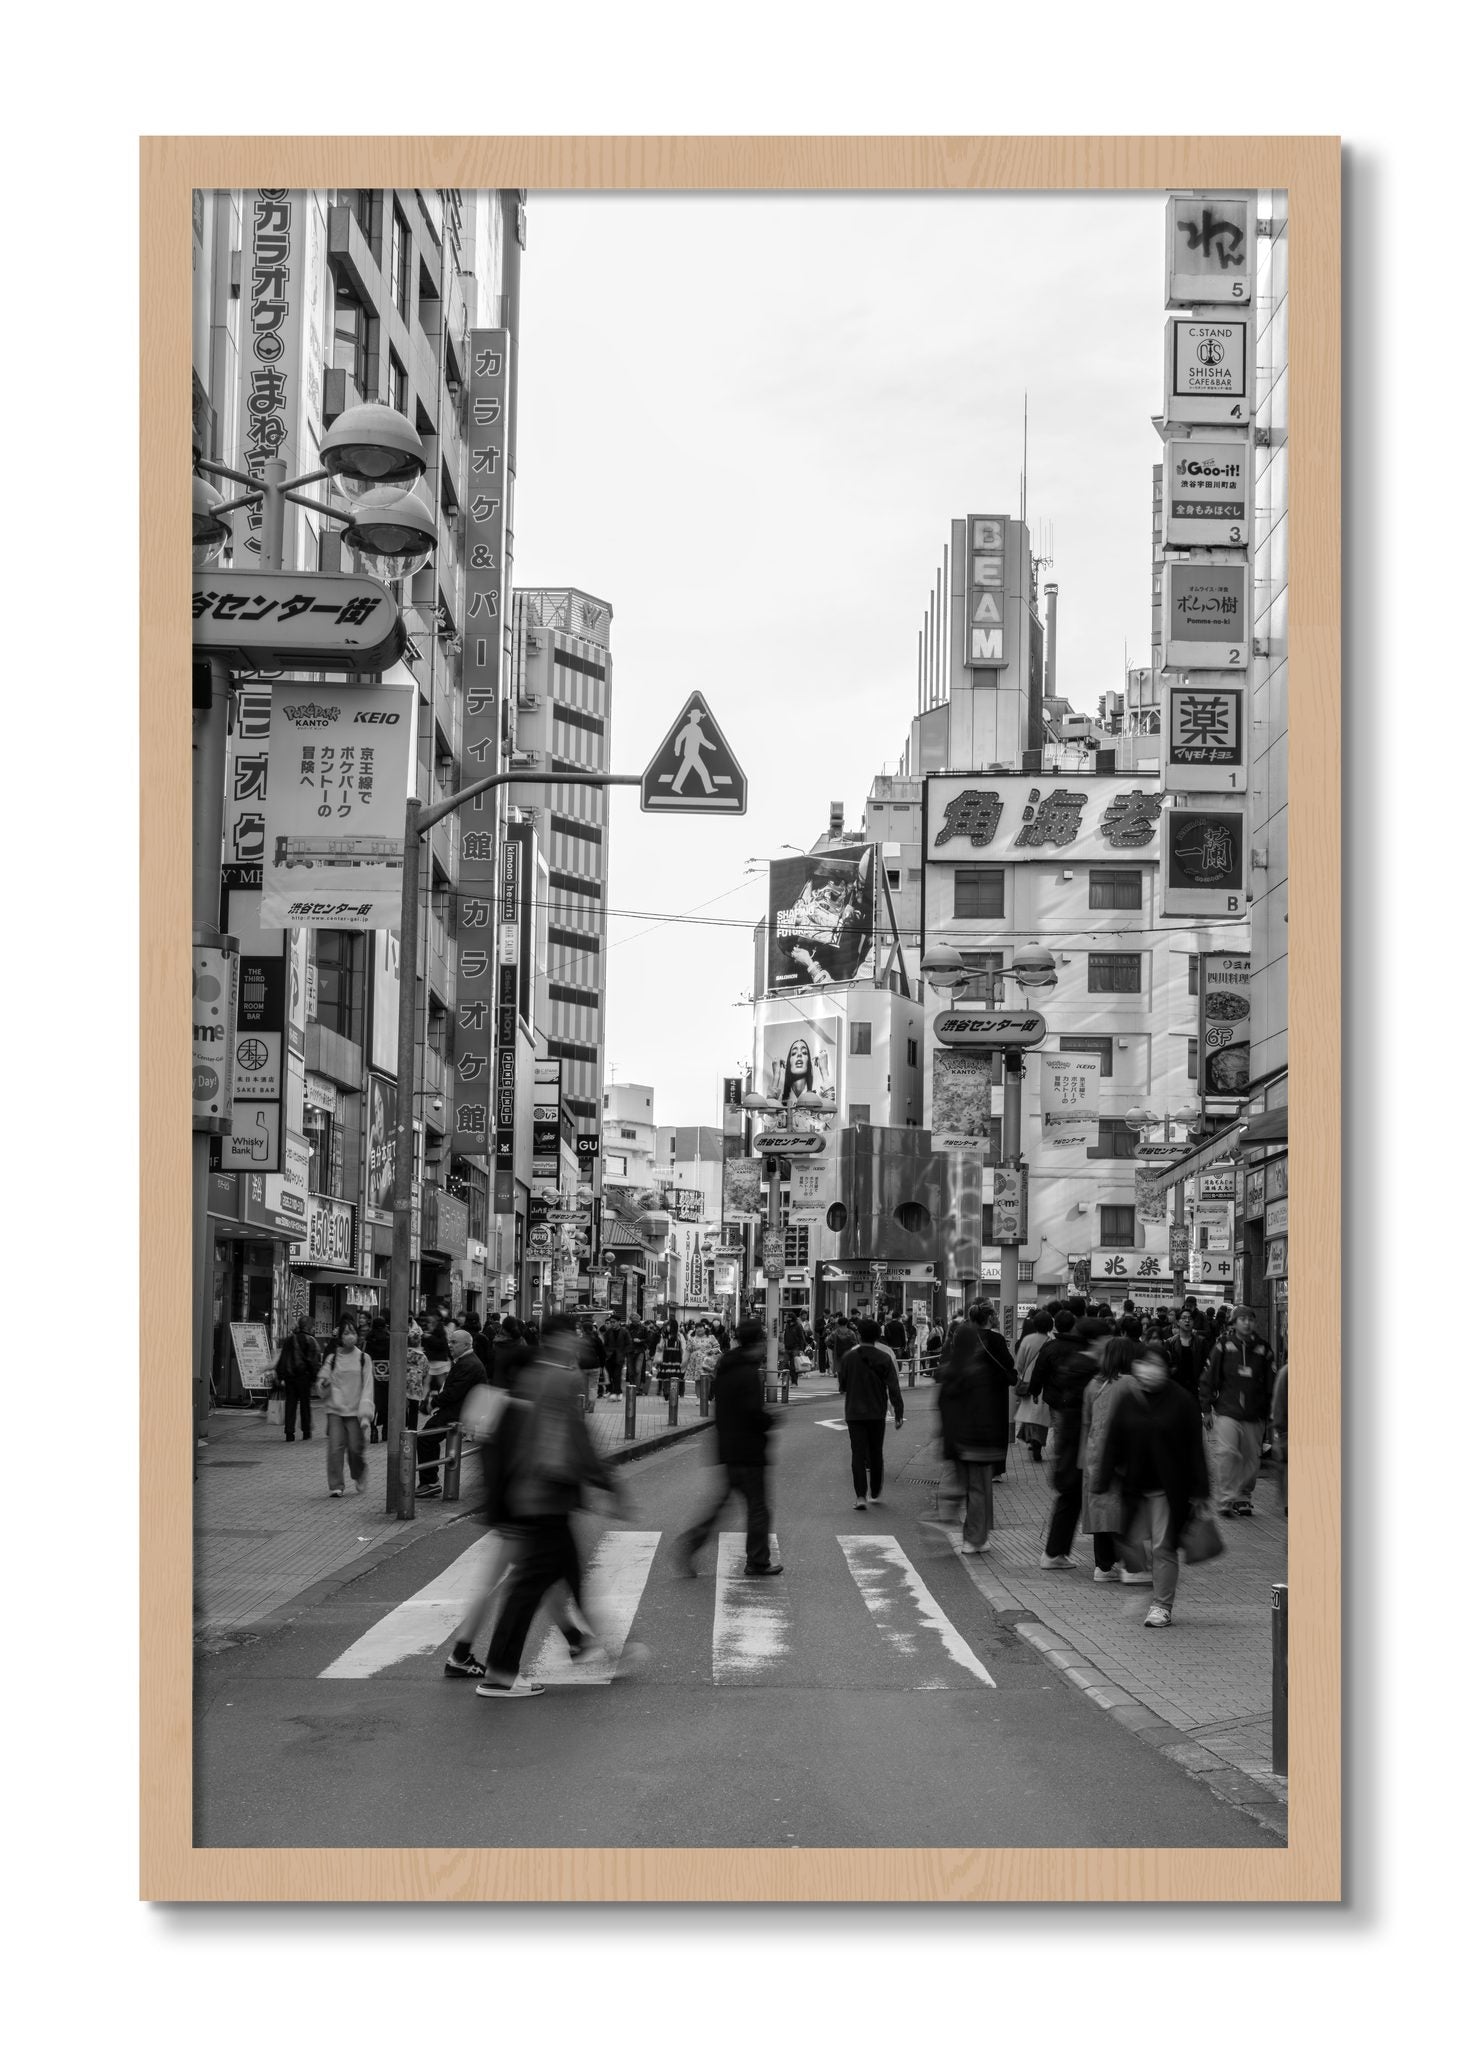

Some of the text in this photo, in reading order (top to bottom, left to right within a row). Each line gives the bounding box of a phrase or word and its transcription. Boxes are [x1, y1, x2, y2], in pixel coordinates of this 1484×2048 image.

[251, 201, 291, 333] カラオケ
[1232, 282, 1243, 297] 5
[1189, 328, 1232, 337] C.STAND
[1189, 368, 1232, 377] SHISHA
[1189, 378, 1232, 386] CAFE&BAR
[1187, 461, 1240, 476] Goo-it!
[1181, 481, 1237, 489] 渋谷宇田川町店
[1176, 505, 1240, 516] 全身もみほぐし
[1229, 526, 1241, 542] 3
[971, 519, 1003, 659] BEAM
[1229, 649, 1240, 664] 2
[353, 712, 400, 724] KEIO
[1180, 697, 1229, 745] 薬
[300, 746, 315, 787] 冒険へ
[318, 746, 335, 817] カントーの
[358, 747, 374, 804] 京王線で
[1229, 773, 1237, 787] 1
[934, 788, 1165, 847] 角海老
[288, 903, 373, 915] 渋谷センター街
[505, 886, 513, 918] hearts
[1228, 896, 1238, 911] B
[456, 900, 490, 1134] カラオケ館
[940, 1019, 1039, 1032] 渋谷センター街
[1206, 1028, 1233, 1047] 6F
[232, 1137, 264, 1148] Whisky
[579, 1141, 598, 1151] GU
[757, 1138, 816, 1146] 渋谷センター街
[1104, 1256, 1161, 1276] 兆楽
[692, 1253, 701, 1295] BEER
